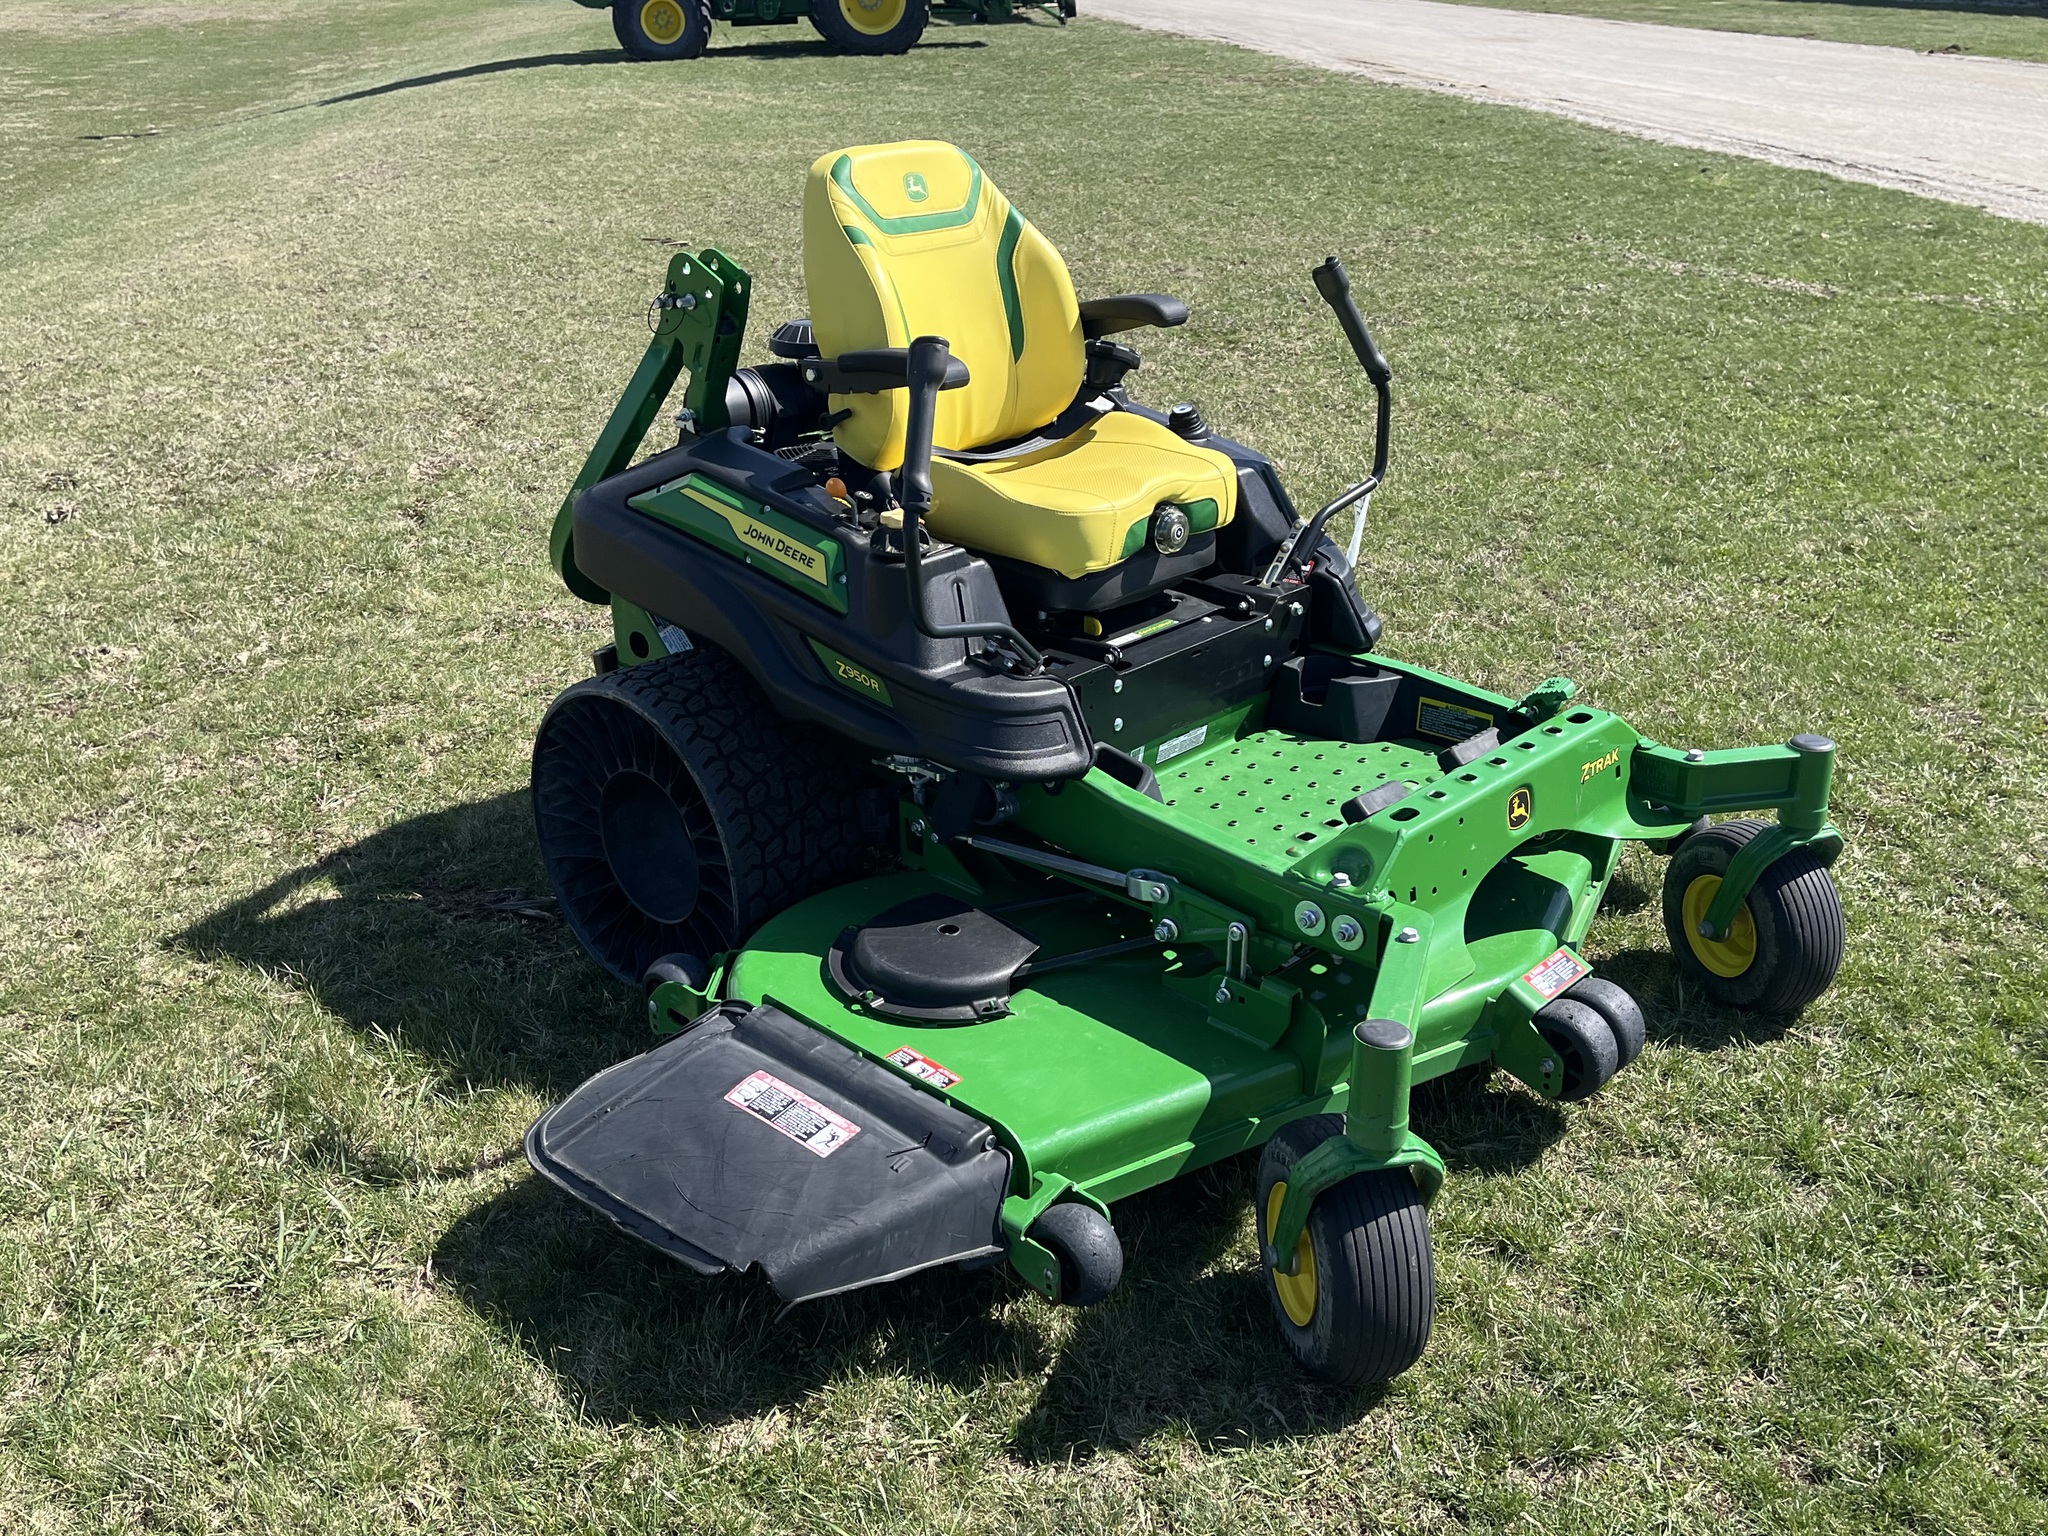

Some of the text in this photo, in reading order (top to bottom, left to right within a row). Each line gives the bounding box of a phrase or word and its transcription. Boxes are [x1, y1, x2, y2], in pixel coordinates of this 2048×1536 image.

[743, 524, 816, 569] JOHN DEERE
[835, 660, 880, 693] Z950R
[1581, 747, 1620, 784] ZTRAK
